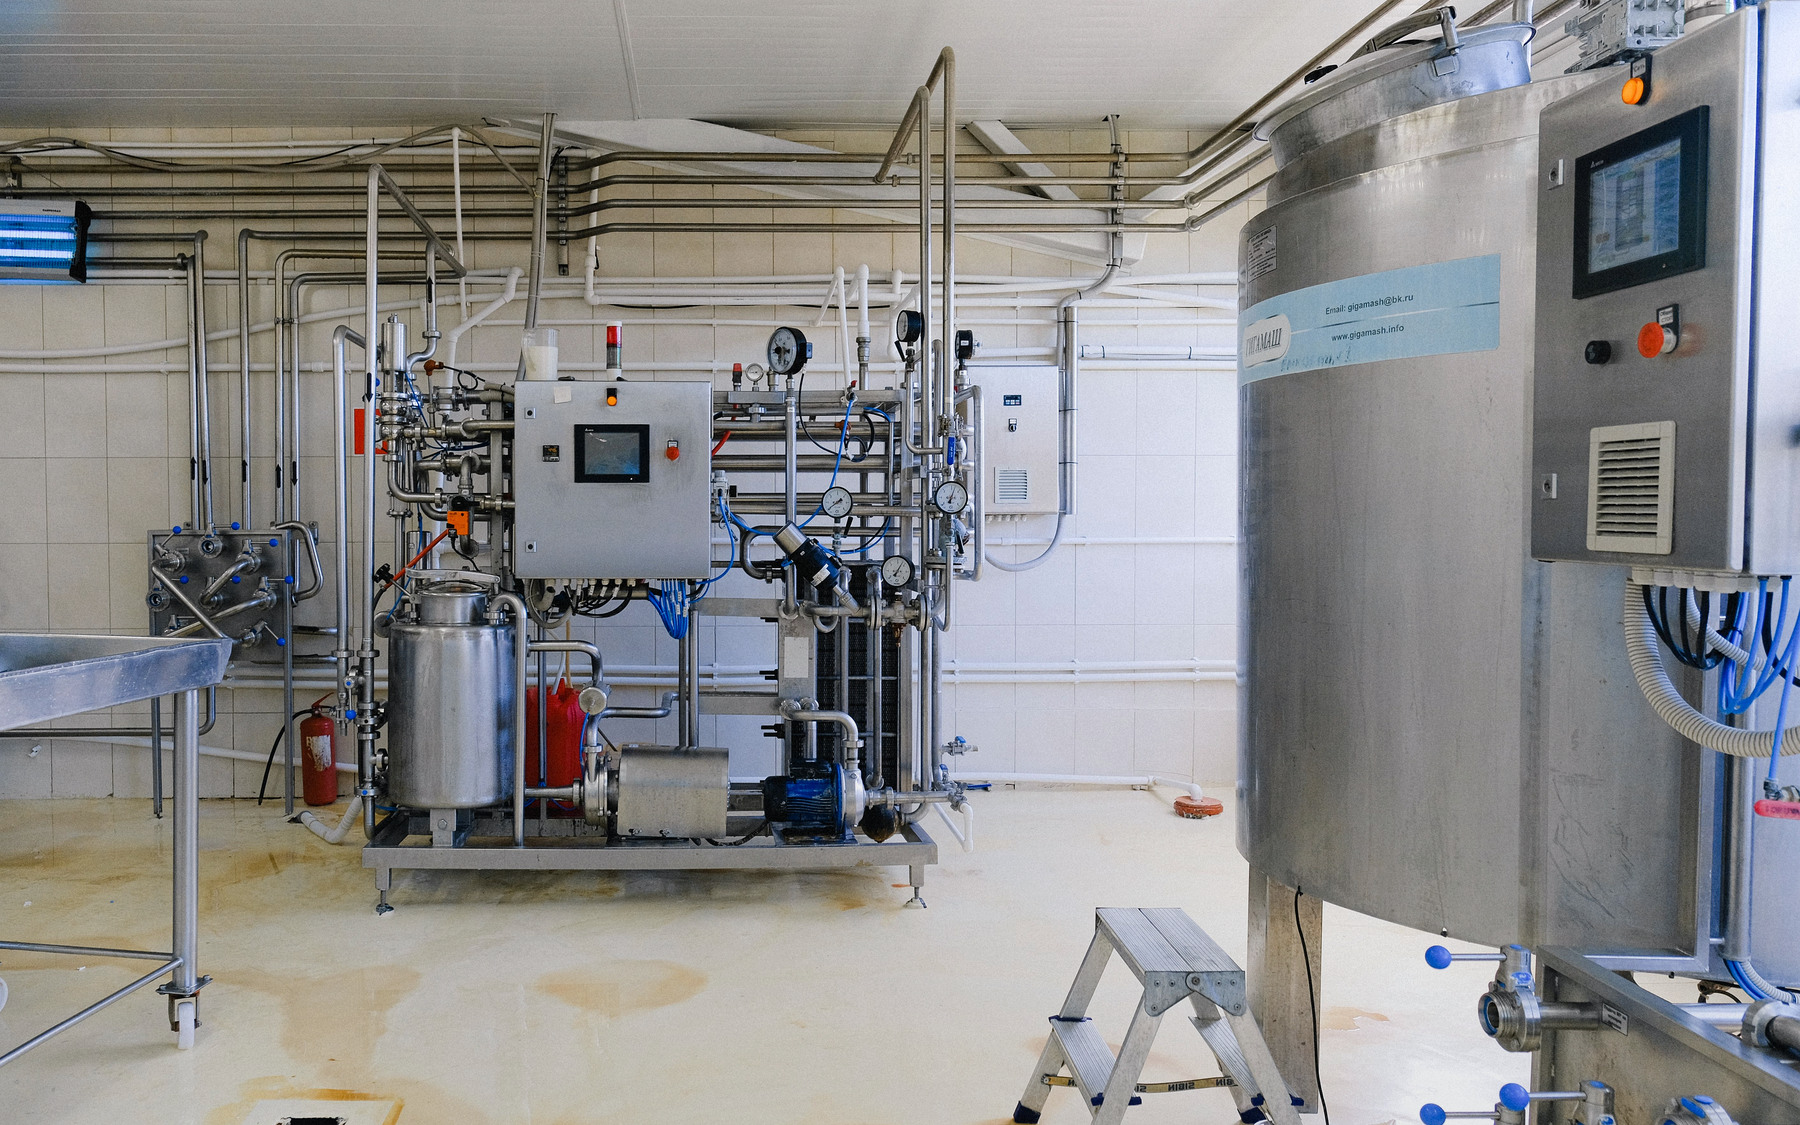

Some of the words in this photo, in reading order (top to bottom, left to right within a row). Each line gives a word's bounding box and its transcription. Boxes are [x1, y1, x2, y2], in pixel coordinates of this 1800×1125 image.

[1325, 304, 1346, 315] Email:
[1347, 294, 1414, 313] gigamash@bk.ru
[1331, 324, 1405, 341] www.gigamash.info
